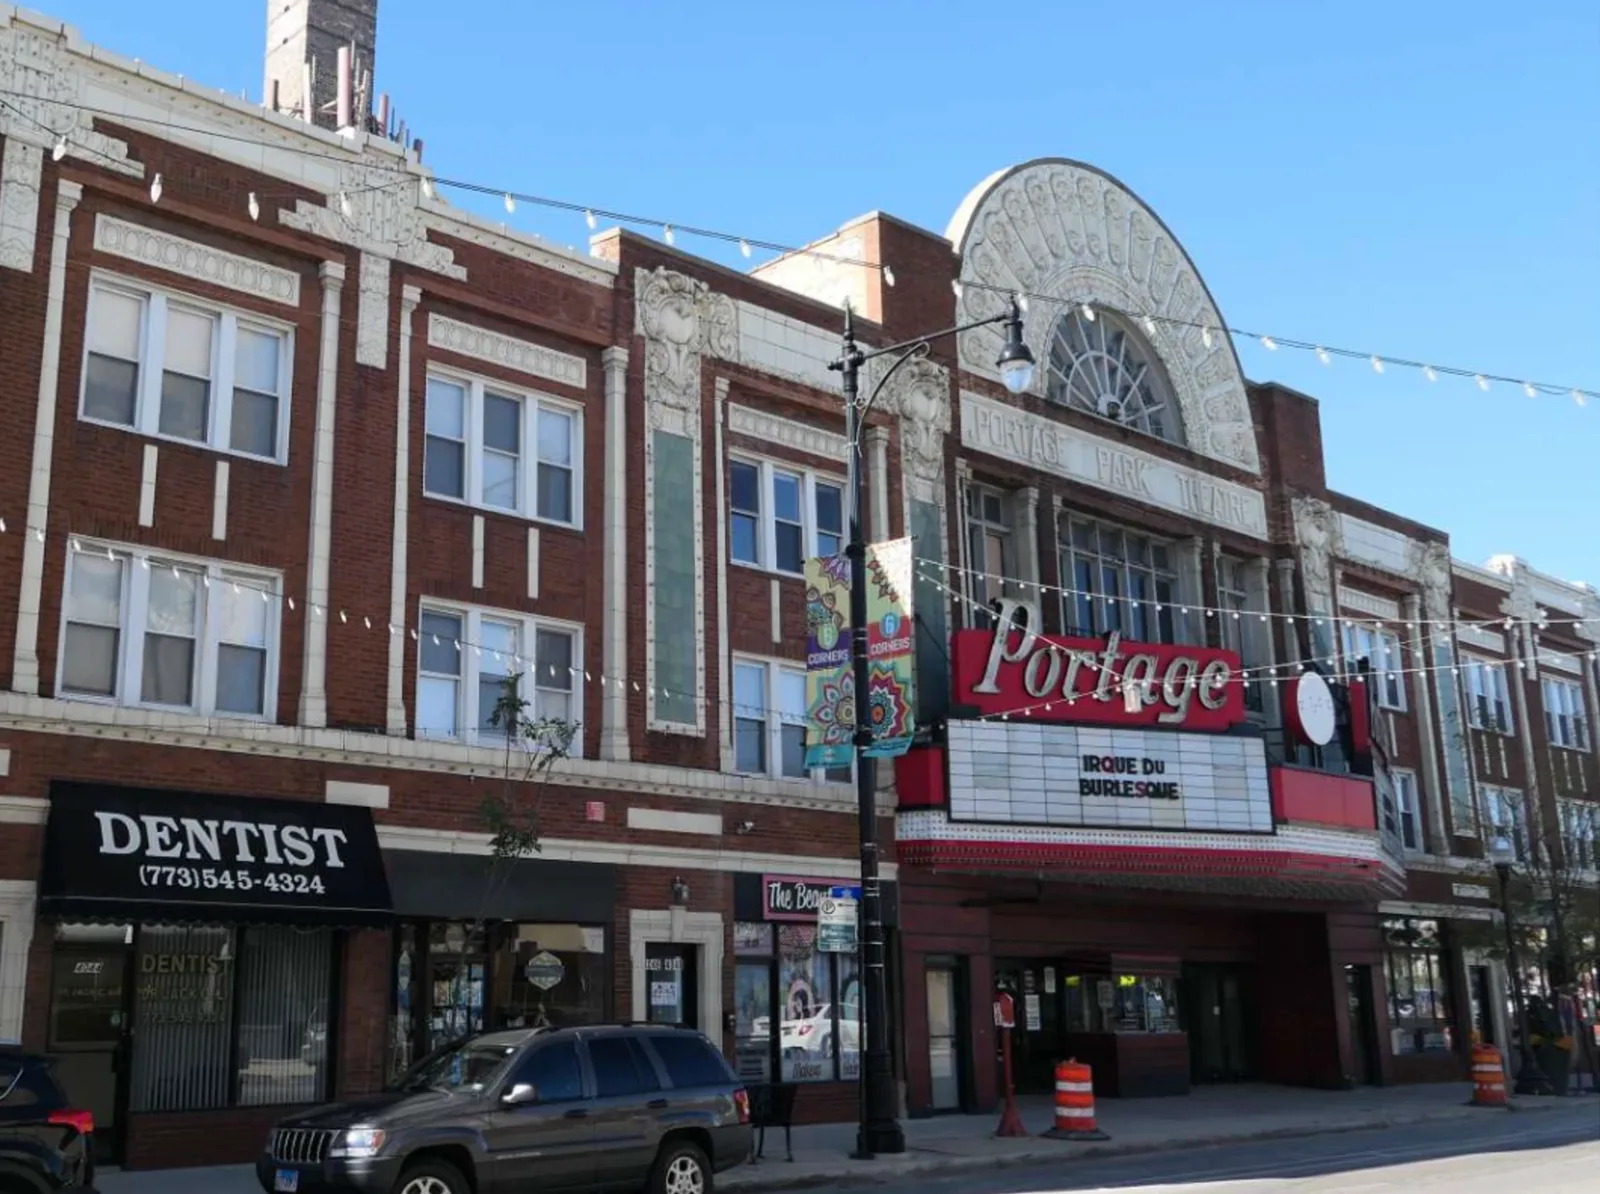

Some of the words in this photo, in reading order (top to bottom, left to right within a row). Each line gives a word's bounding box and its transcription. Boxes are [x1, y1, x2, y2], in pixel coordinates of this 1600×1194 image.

[1096, 447, 1149, 496] PARK
[885, 614, 896, 634] 6
[807, 648, 849, 666] CORNERS
[870, 637, 910, 656] CORNERS
[973, 598, 1230, 723] Portage
[1083, 754, 1137, 775] IRQUE
[1143, 758, 1165, 775] DU
[1080, 779, 1179, 801] BURLESQUE
[94, 811, 348, 868] DENTIST
[139, 864, 326, 895] (773)545-4324
[768, 881, 794, 910] The
